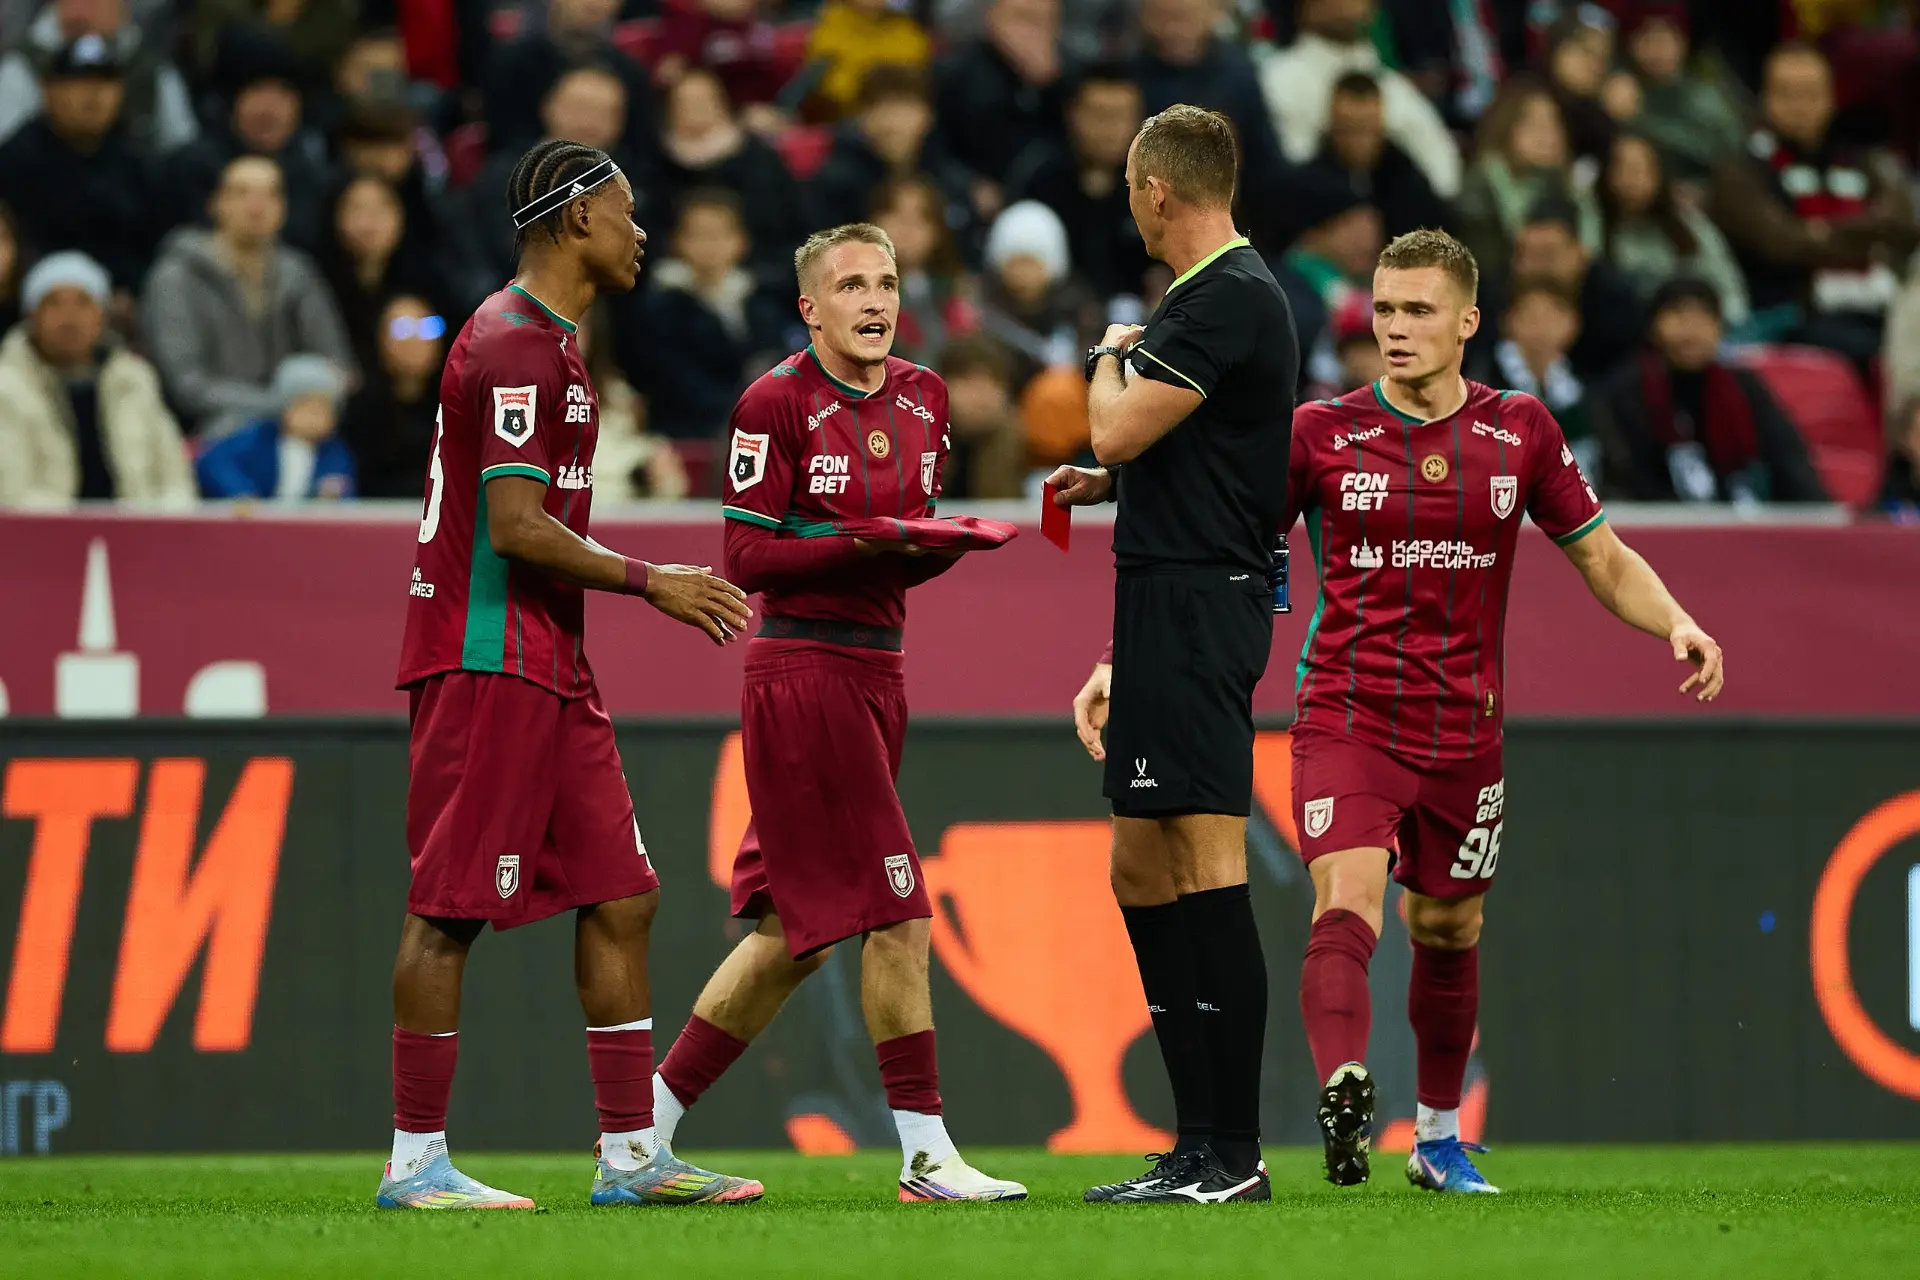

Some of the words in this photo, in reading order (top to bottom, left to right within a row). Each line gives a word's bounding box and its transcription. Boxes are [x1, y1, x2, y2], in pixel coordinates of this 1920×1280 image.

[565, 405, 591, 422] BET
[808, 454, 849, 473] FON
[808, 475, 850, 493] BET
[1340, 472, 1389, 491] FON
[1342, 492, 1389, 511] BET
[1392, 540, 1474, 555] КАЗАНЬ
[1391, 552, 1496, 569] ОРГСИНТЕЗ
[1450, 820, 1504, 879] 98
[0, 757, 295, 1053] ТИ
[0, 1080, 71, 1155] ГР
